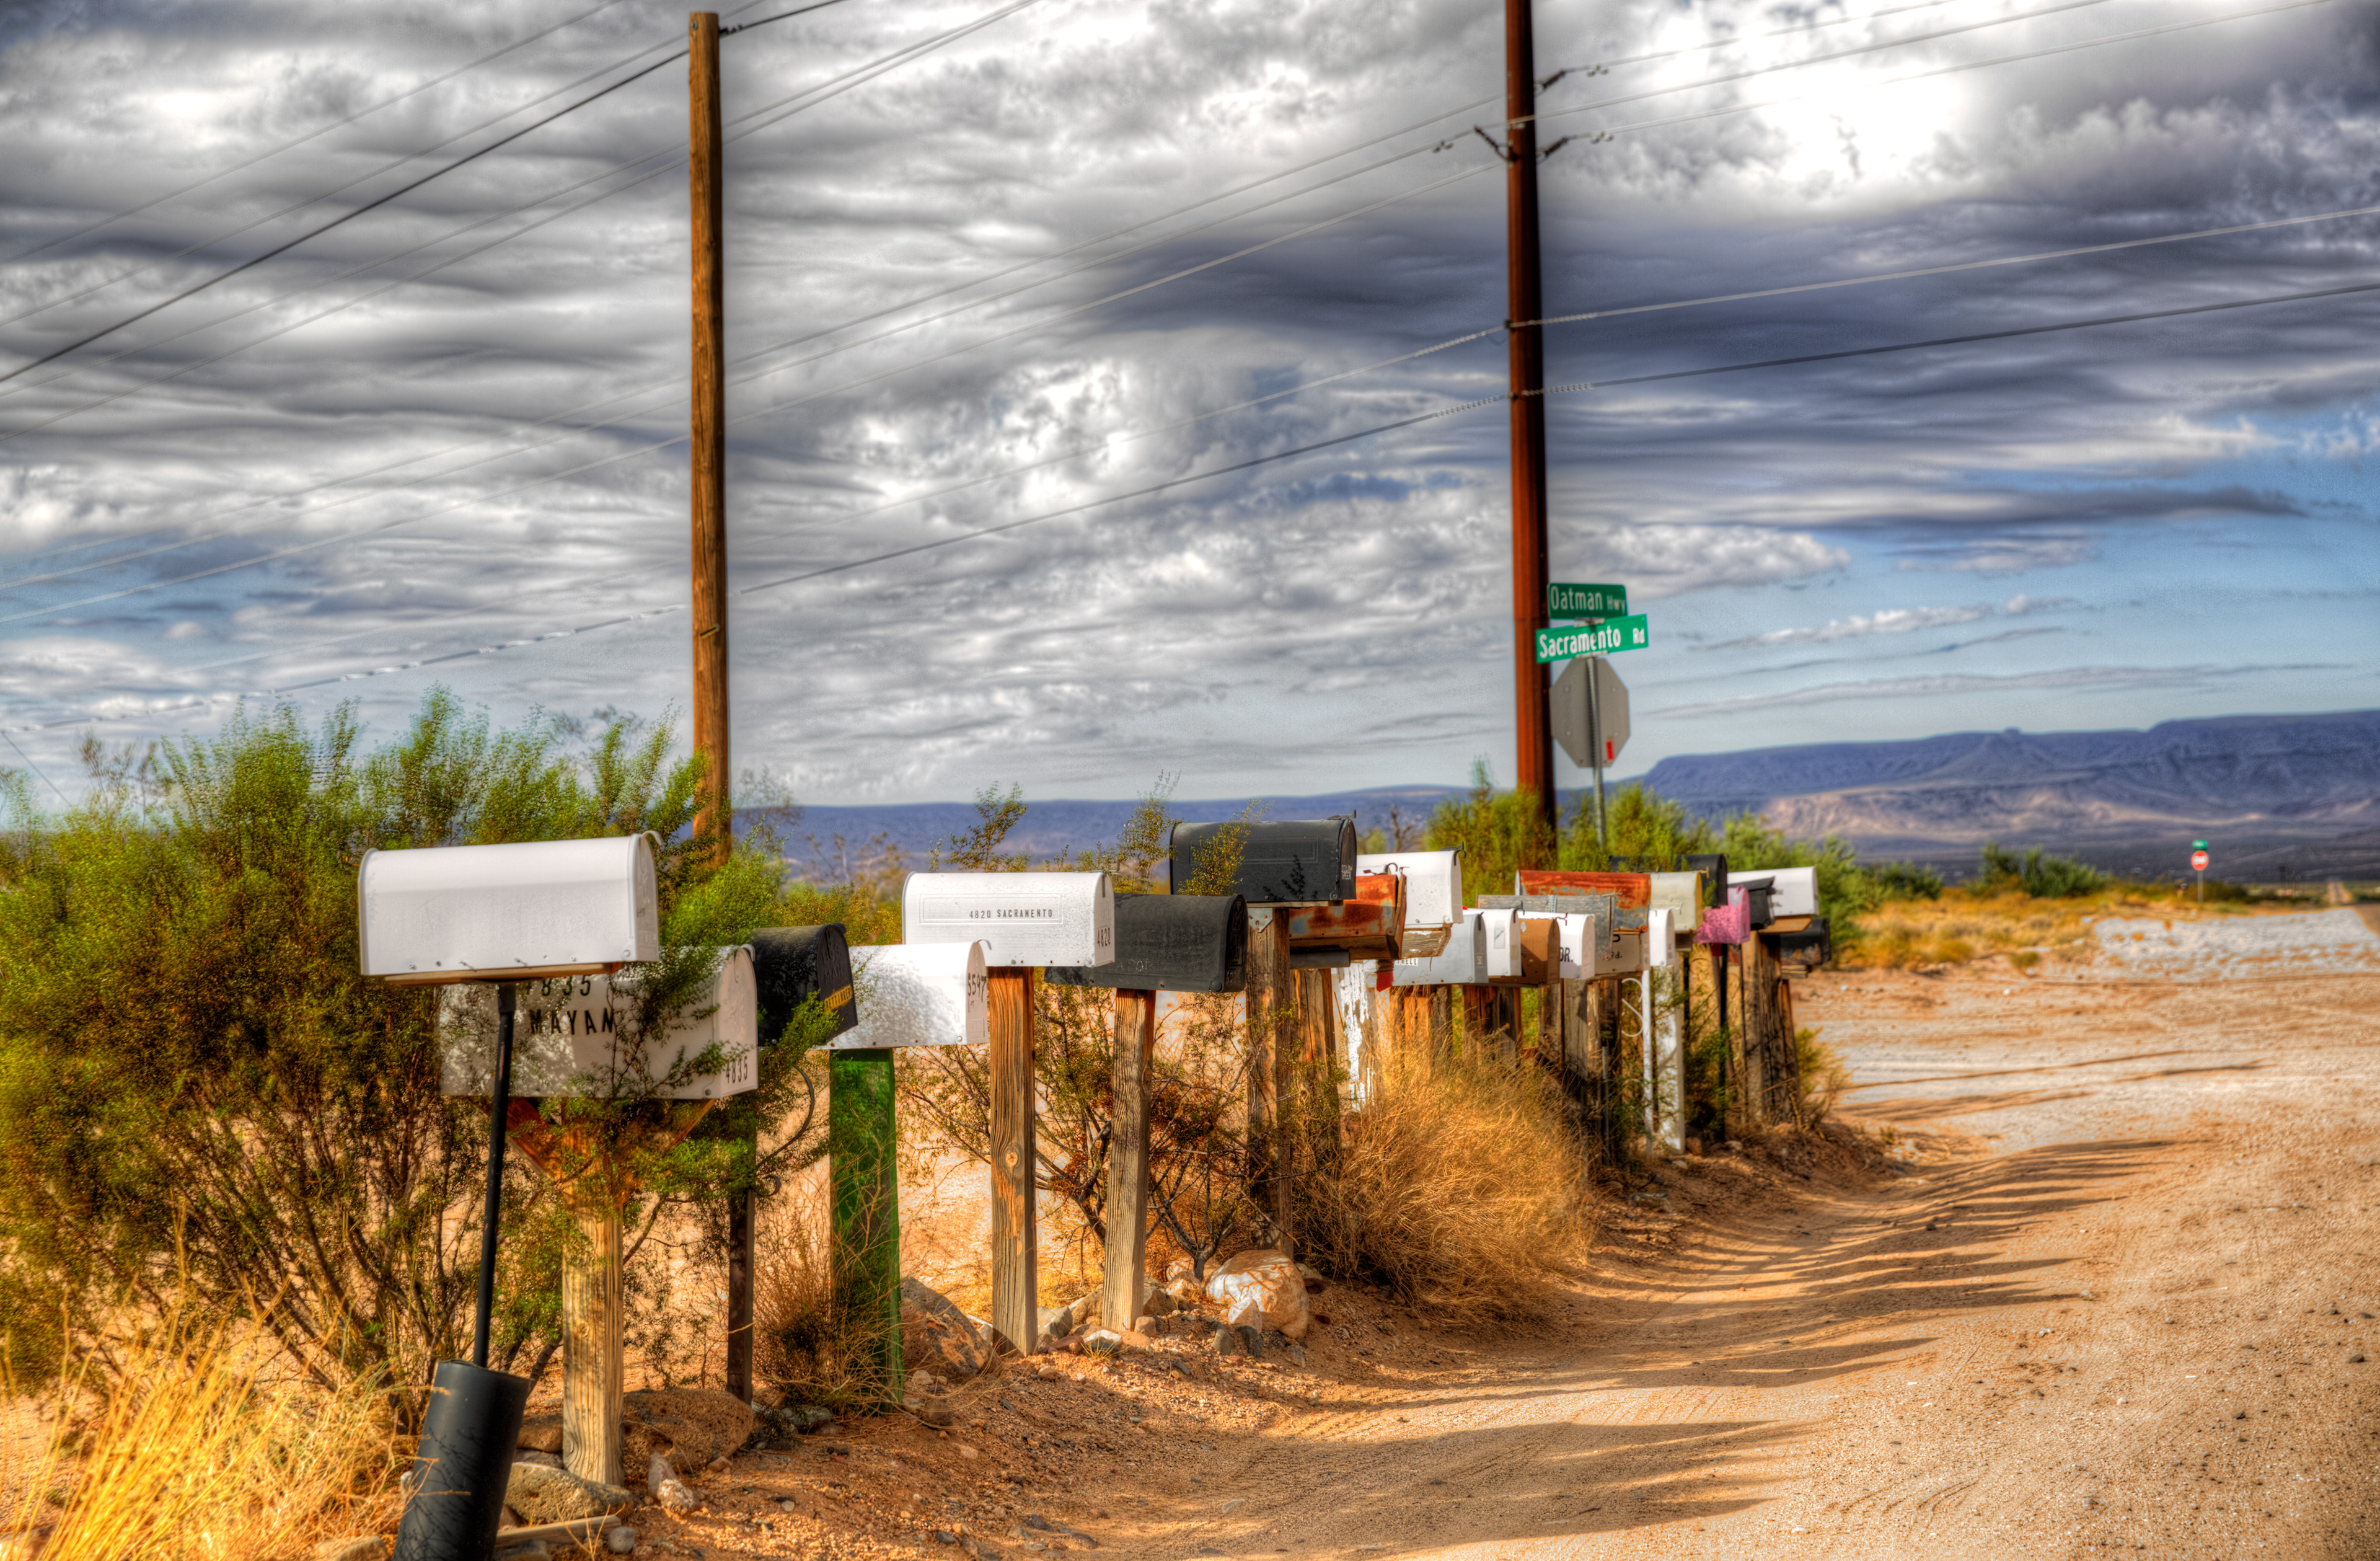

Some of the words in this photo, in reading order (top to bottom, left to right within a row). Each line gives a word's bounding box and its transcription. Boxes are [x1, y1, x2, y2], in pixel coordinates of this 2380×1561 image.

[1551, 586, 1603, 611] Oatman
[1607, 596, 1626, 614] Hwy
[1539, 626, 1621, 658] Sacramento
[1633, 628, 1645, 644] Rd
[969, 910, 991, 918] 4820
[997, 909, 1052, 918] SACRAMENTO
[1097, 927, 1111, 948] 4820
[967, 973, 987, 1003] 5597
[529, 1007, 614, 1035] MAYAN
[726, 1055, 748, 1084] 4835
